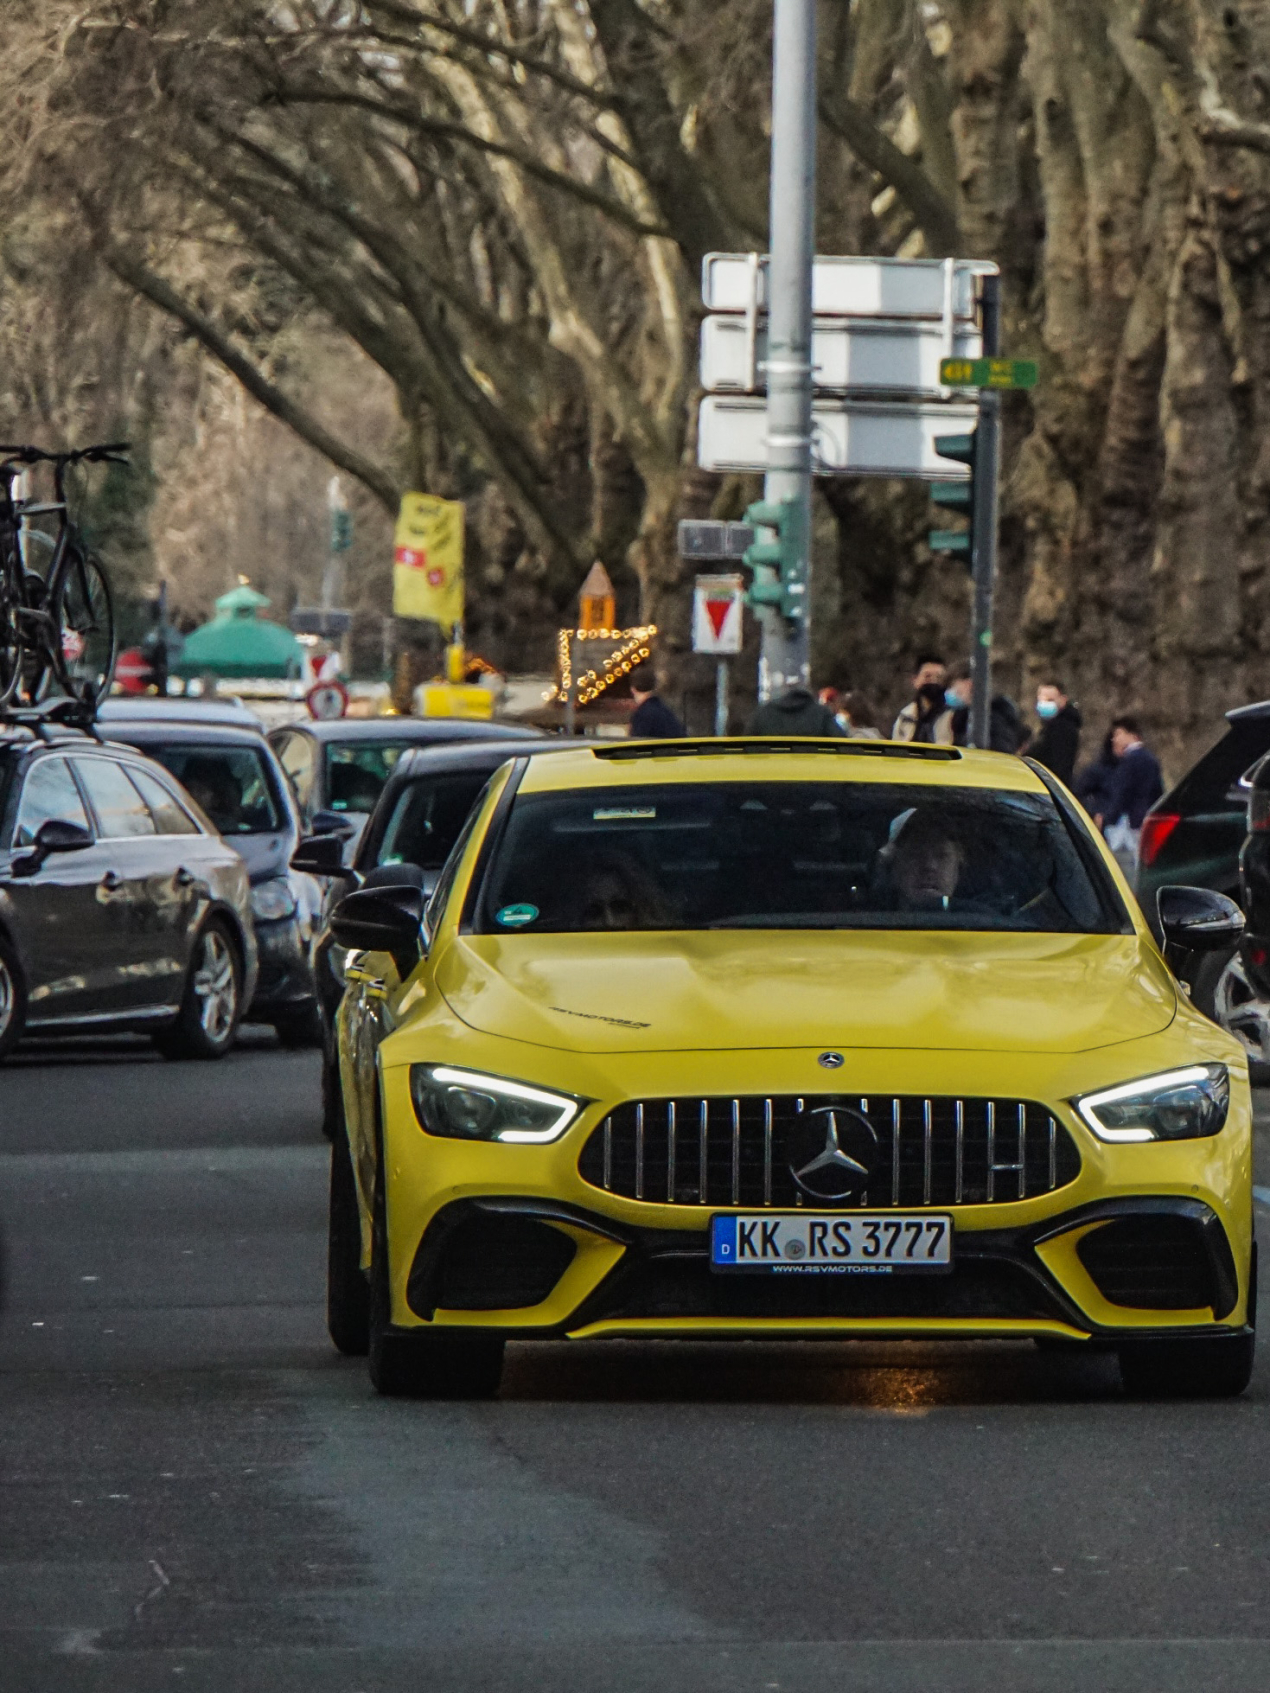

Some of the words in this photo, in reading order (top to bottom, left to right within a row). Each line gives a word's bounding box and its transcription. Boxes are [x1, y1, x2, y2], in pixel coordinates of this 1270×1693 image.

[738, 1220, 781, 1257] KK
[808, 1220, 852, 1257] RS
[861, 1220, 946, 1257] 3777
[721, 1243, 731, 1255] D
[772, 1265, 893, 1273] WWW.RSVMOTORS.DE
